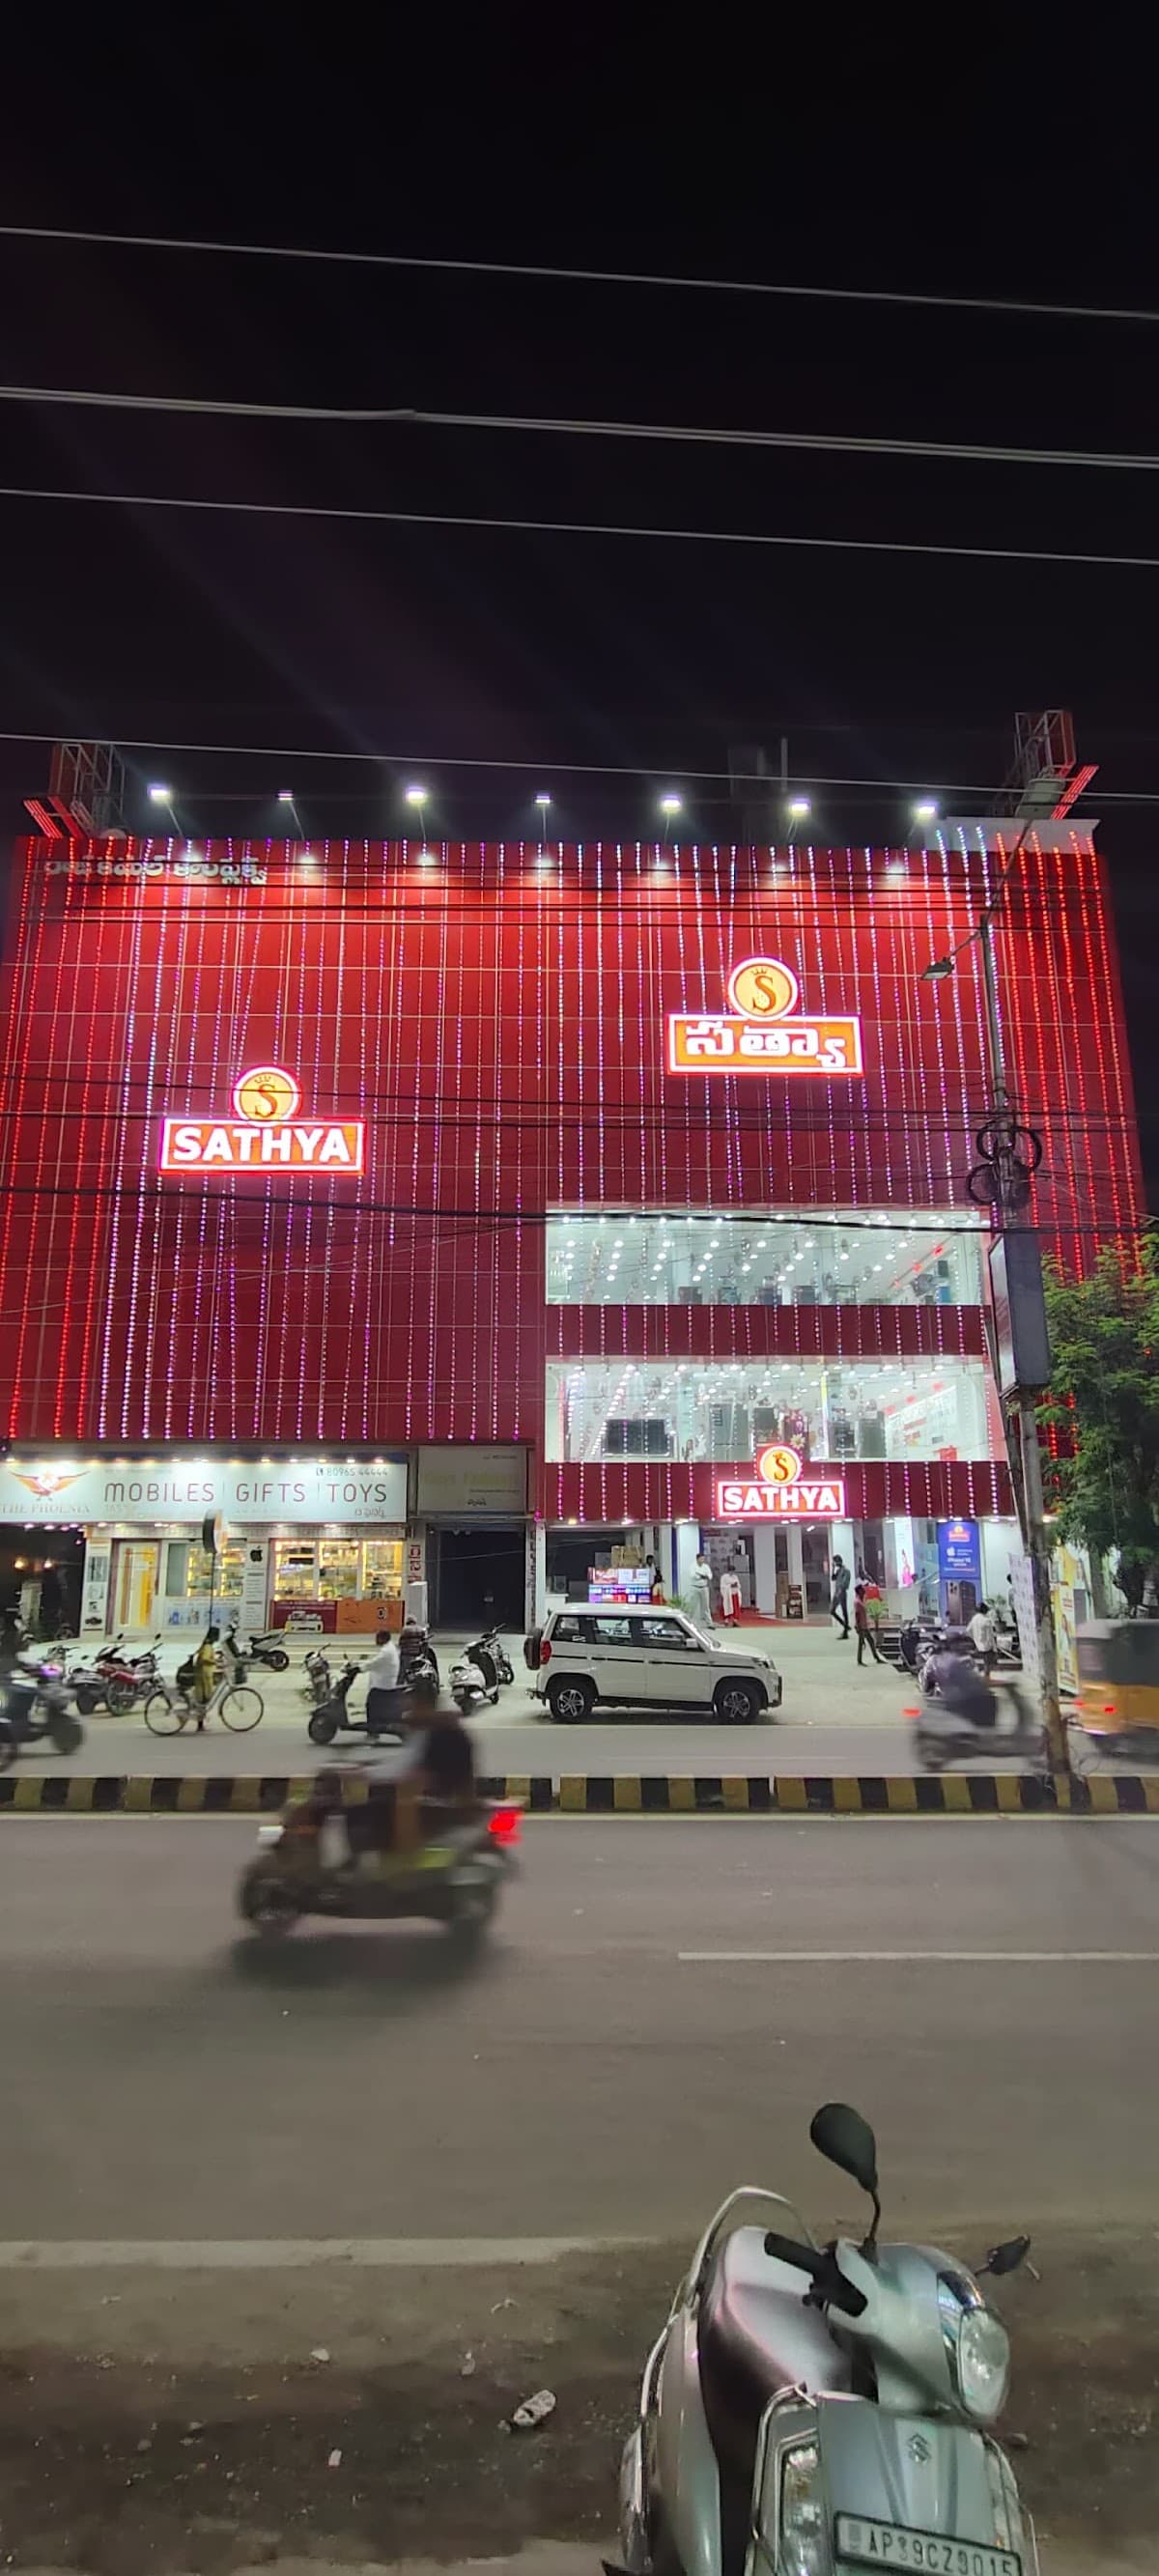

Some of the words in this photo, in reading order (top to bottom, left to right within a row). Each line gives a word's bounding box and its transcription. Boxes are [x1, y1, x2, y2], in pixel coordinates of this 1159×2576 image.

[686, 1020, 848, 1068] సత్యా
[173, 1125, 351, 1163] SATHYA
[104, 1483, 214, 1503] MOBILES
[236, 1483, 306, 1503] GIFTS
[326, 1483, 387, 1503] TOYS
[724, 1486, 838, 1513] SATHYA
